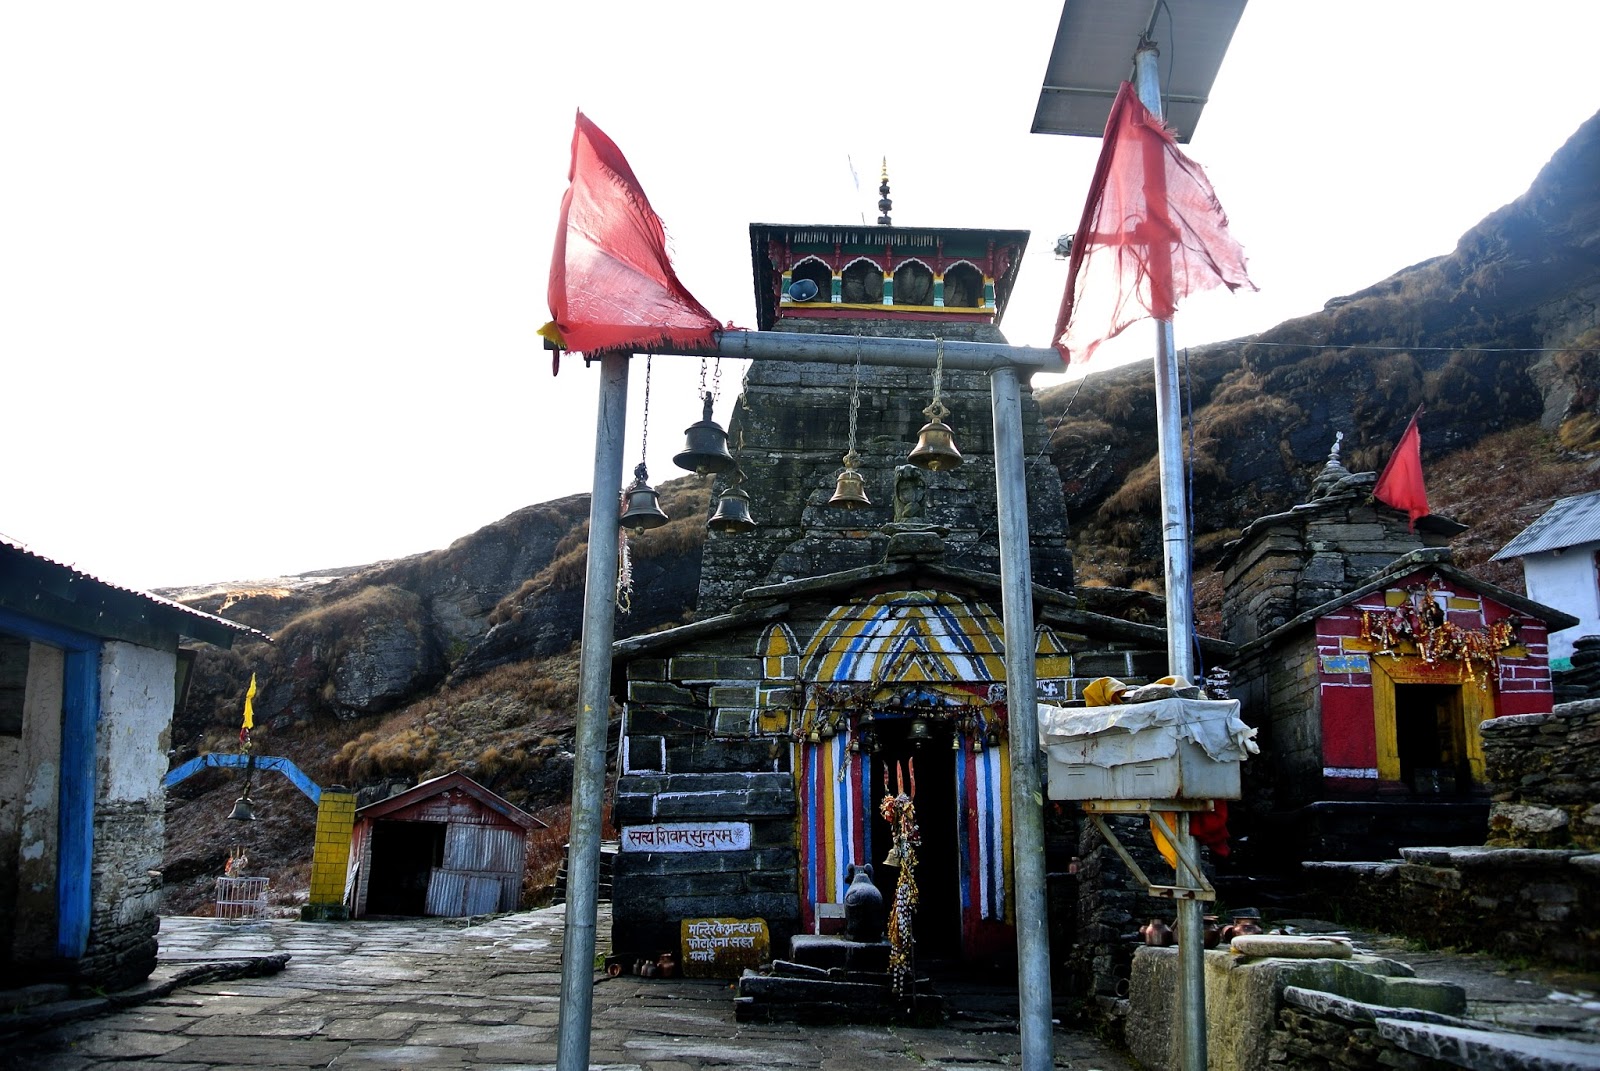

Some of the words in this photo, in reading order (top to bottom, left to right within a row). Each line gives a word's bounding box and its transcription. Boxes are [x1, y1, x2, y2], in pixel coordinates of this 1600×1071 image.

[628, 831, 654, 846] सत्य
[656, 826, 693, 847] शिवम्
[689, 829, 736, 848] सुन्दरम्
[688, 921, 716, 936] मन्दिर
[714, 920, 725, 934] के
[723, 923, 749, 936] अन्दर
[749, 922, 763, 934] का
[686, 935, 709, 949] फोटो
[709, 935, 729, 948] लेना
[689, 951, 707, 961] मना
[706, 947, 715, 963] है
